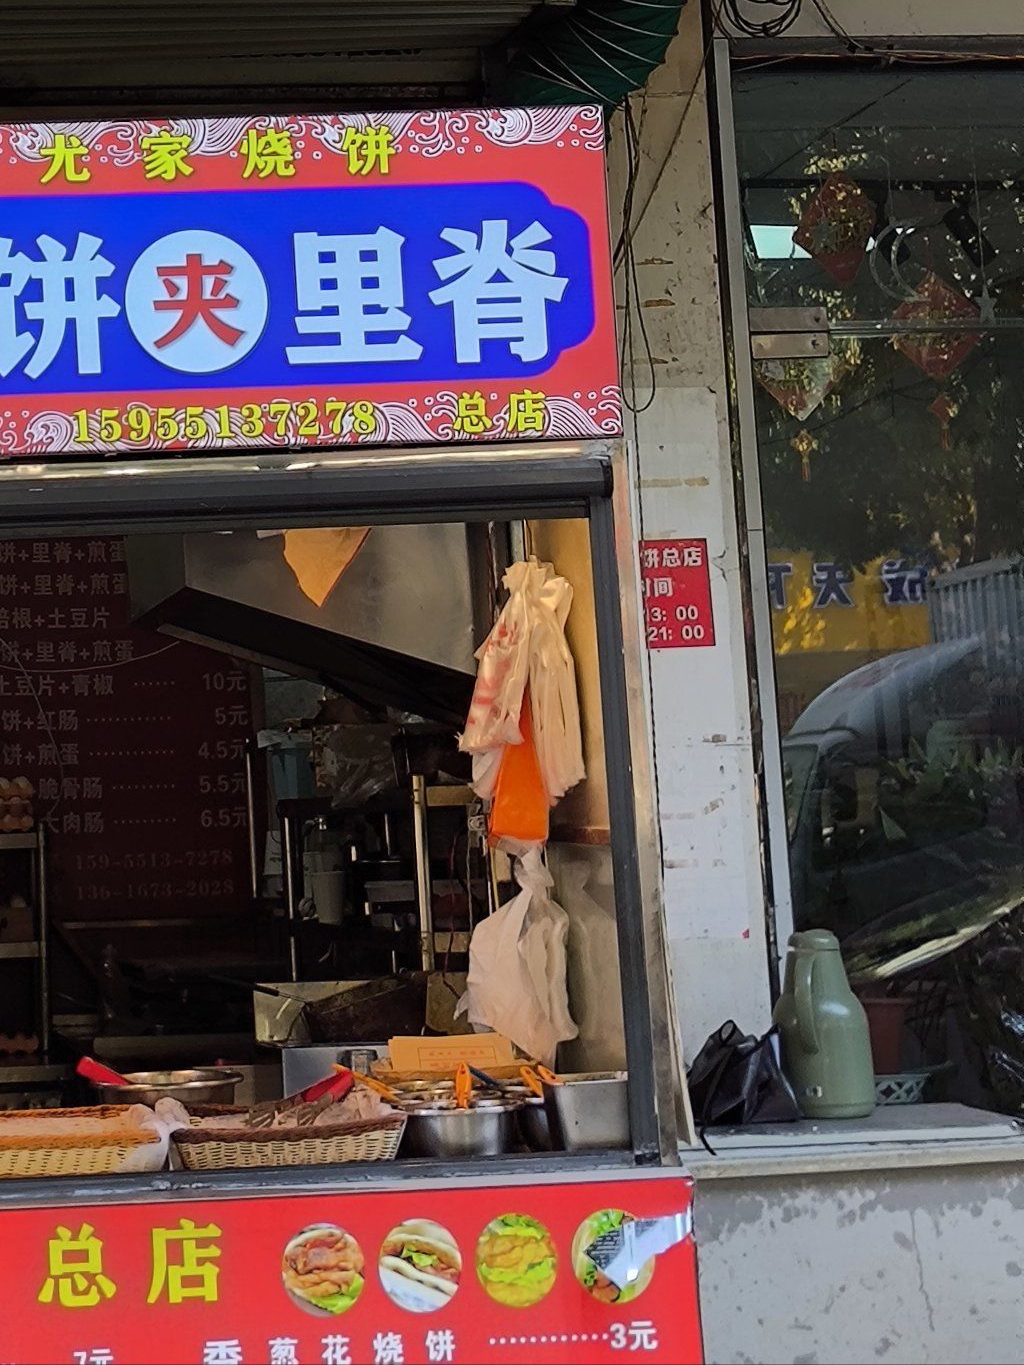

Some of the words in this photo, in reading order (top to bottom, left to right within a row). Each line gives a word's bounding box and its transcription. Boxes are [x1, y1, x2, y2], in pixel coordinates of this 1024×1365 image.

[73, 400, 376, 443] 15955137278
[453, 389, 546, 435] 总店
[202, 670, 247, 692] 10元
[214, 705, 249, 726] 5元
[198, 740, 247, 761] 4.5元
[199, 773, 247, 794] 5.5元
[199, 807, 248, 829] 6.5元
[38, 1218, 222, 1307] 总店
[609, 1320, 658, 1351] 3元
